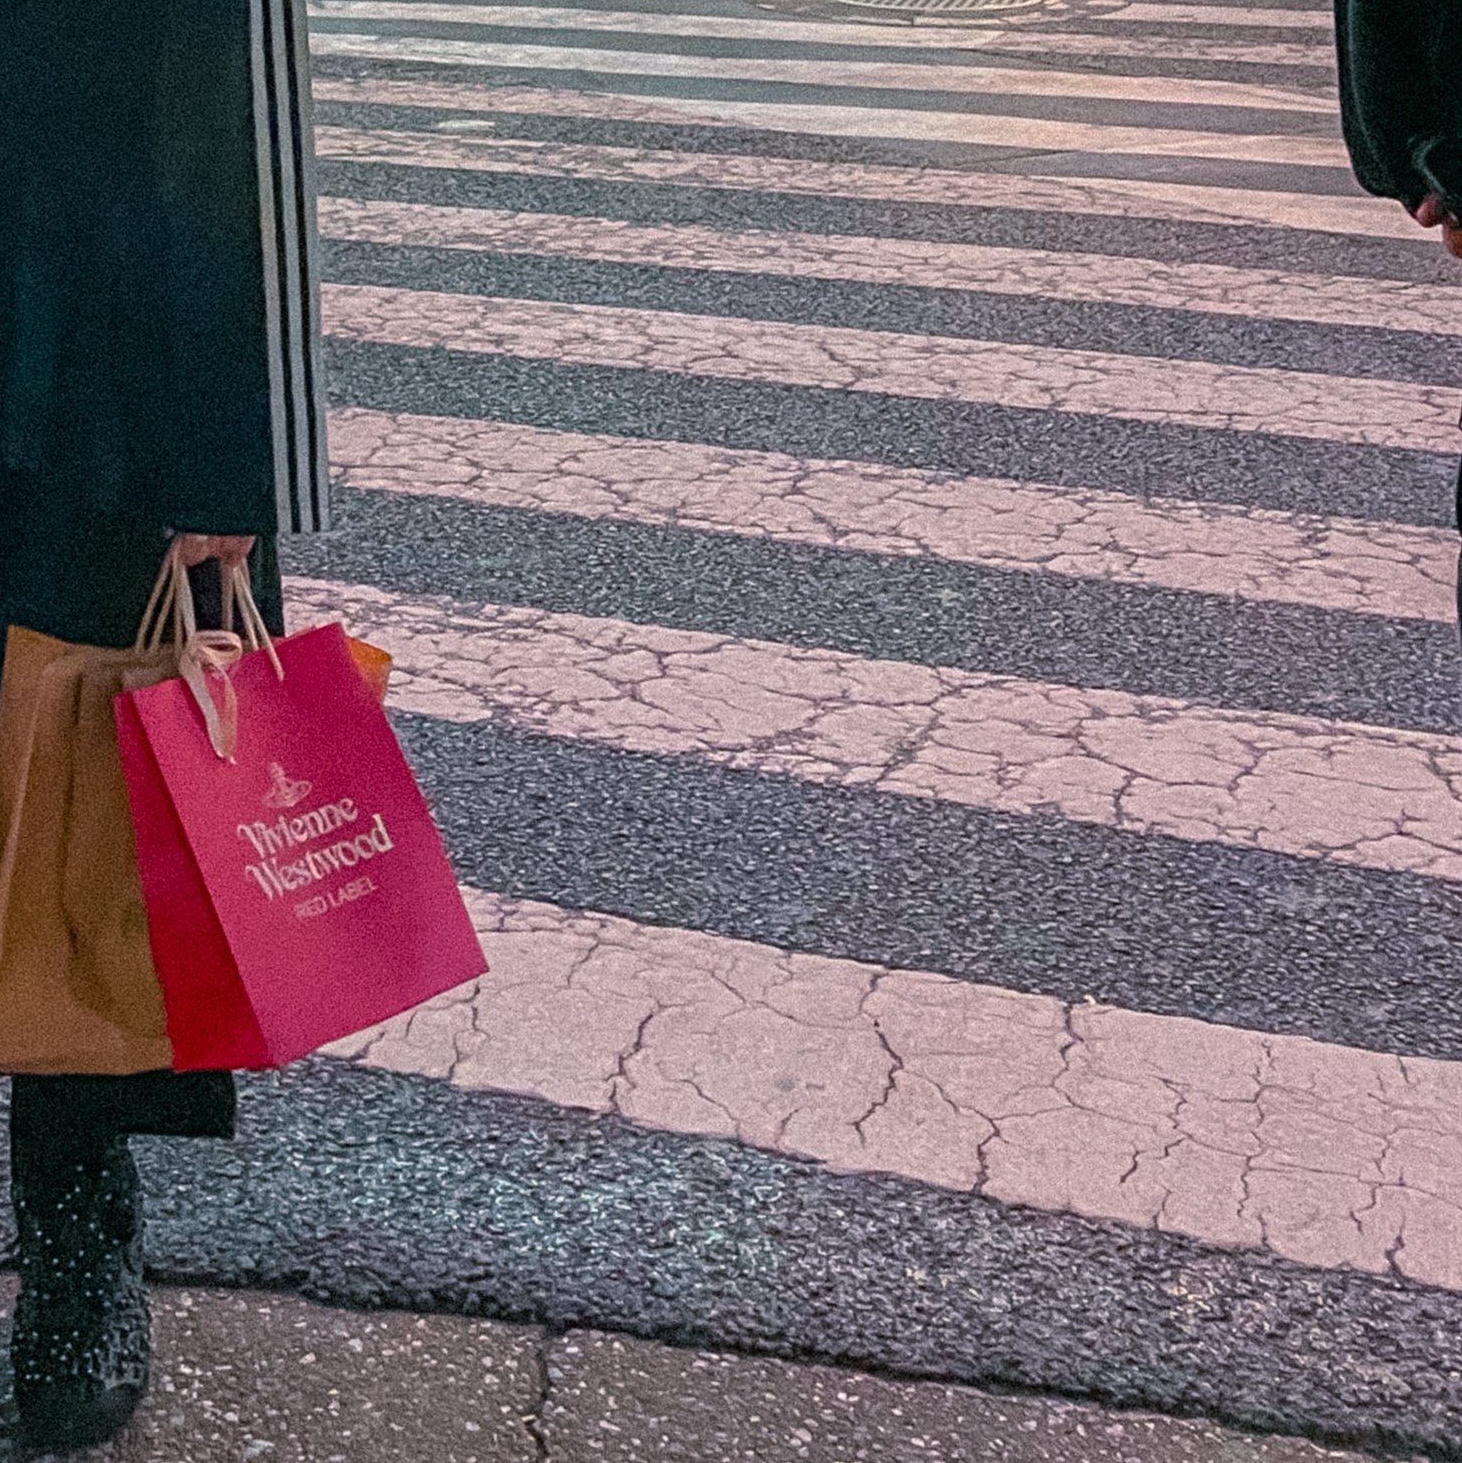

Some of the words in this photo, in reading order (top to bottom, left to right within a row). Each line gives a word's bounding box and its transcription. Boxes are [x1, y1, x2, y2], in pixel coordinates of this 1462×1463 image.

[236, 797, 359, 858] Vivienne
[244, 813, 394, 902] Westwood
[293, 896, 328, 920] RED
[327, 876, 380, 908] LABEL
